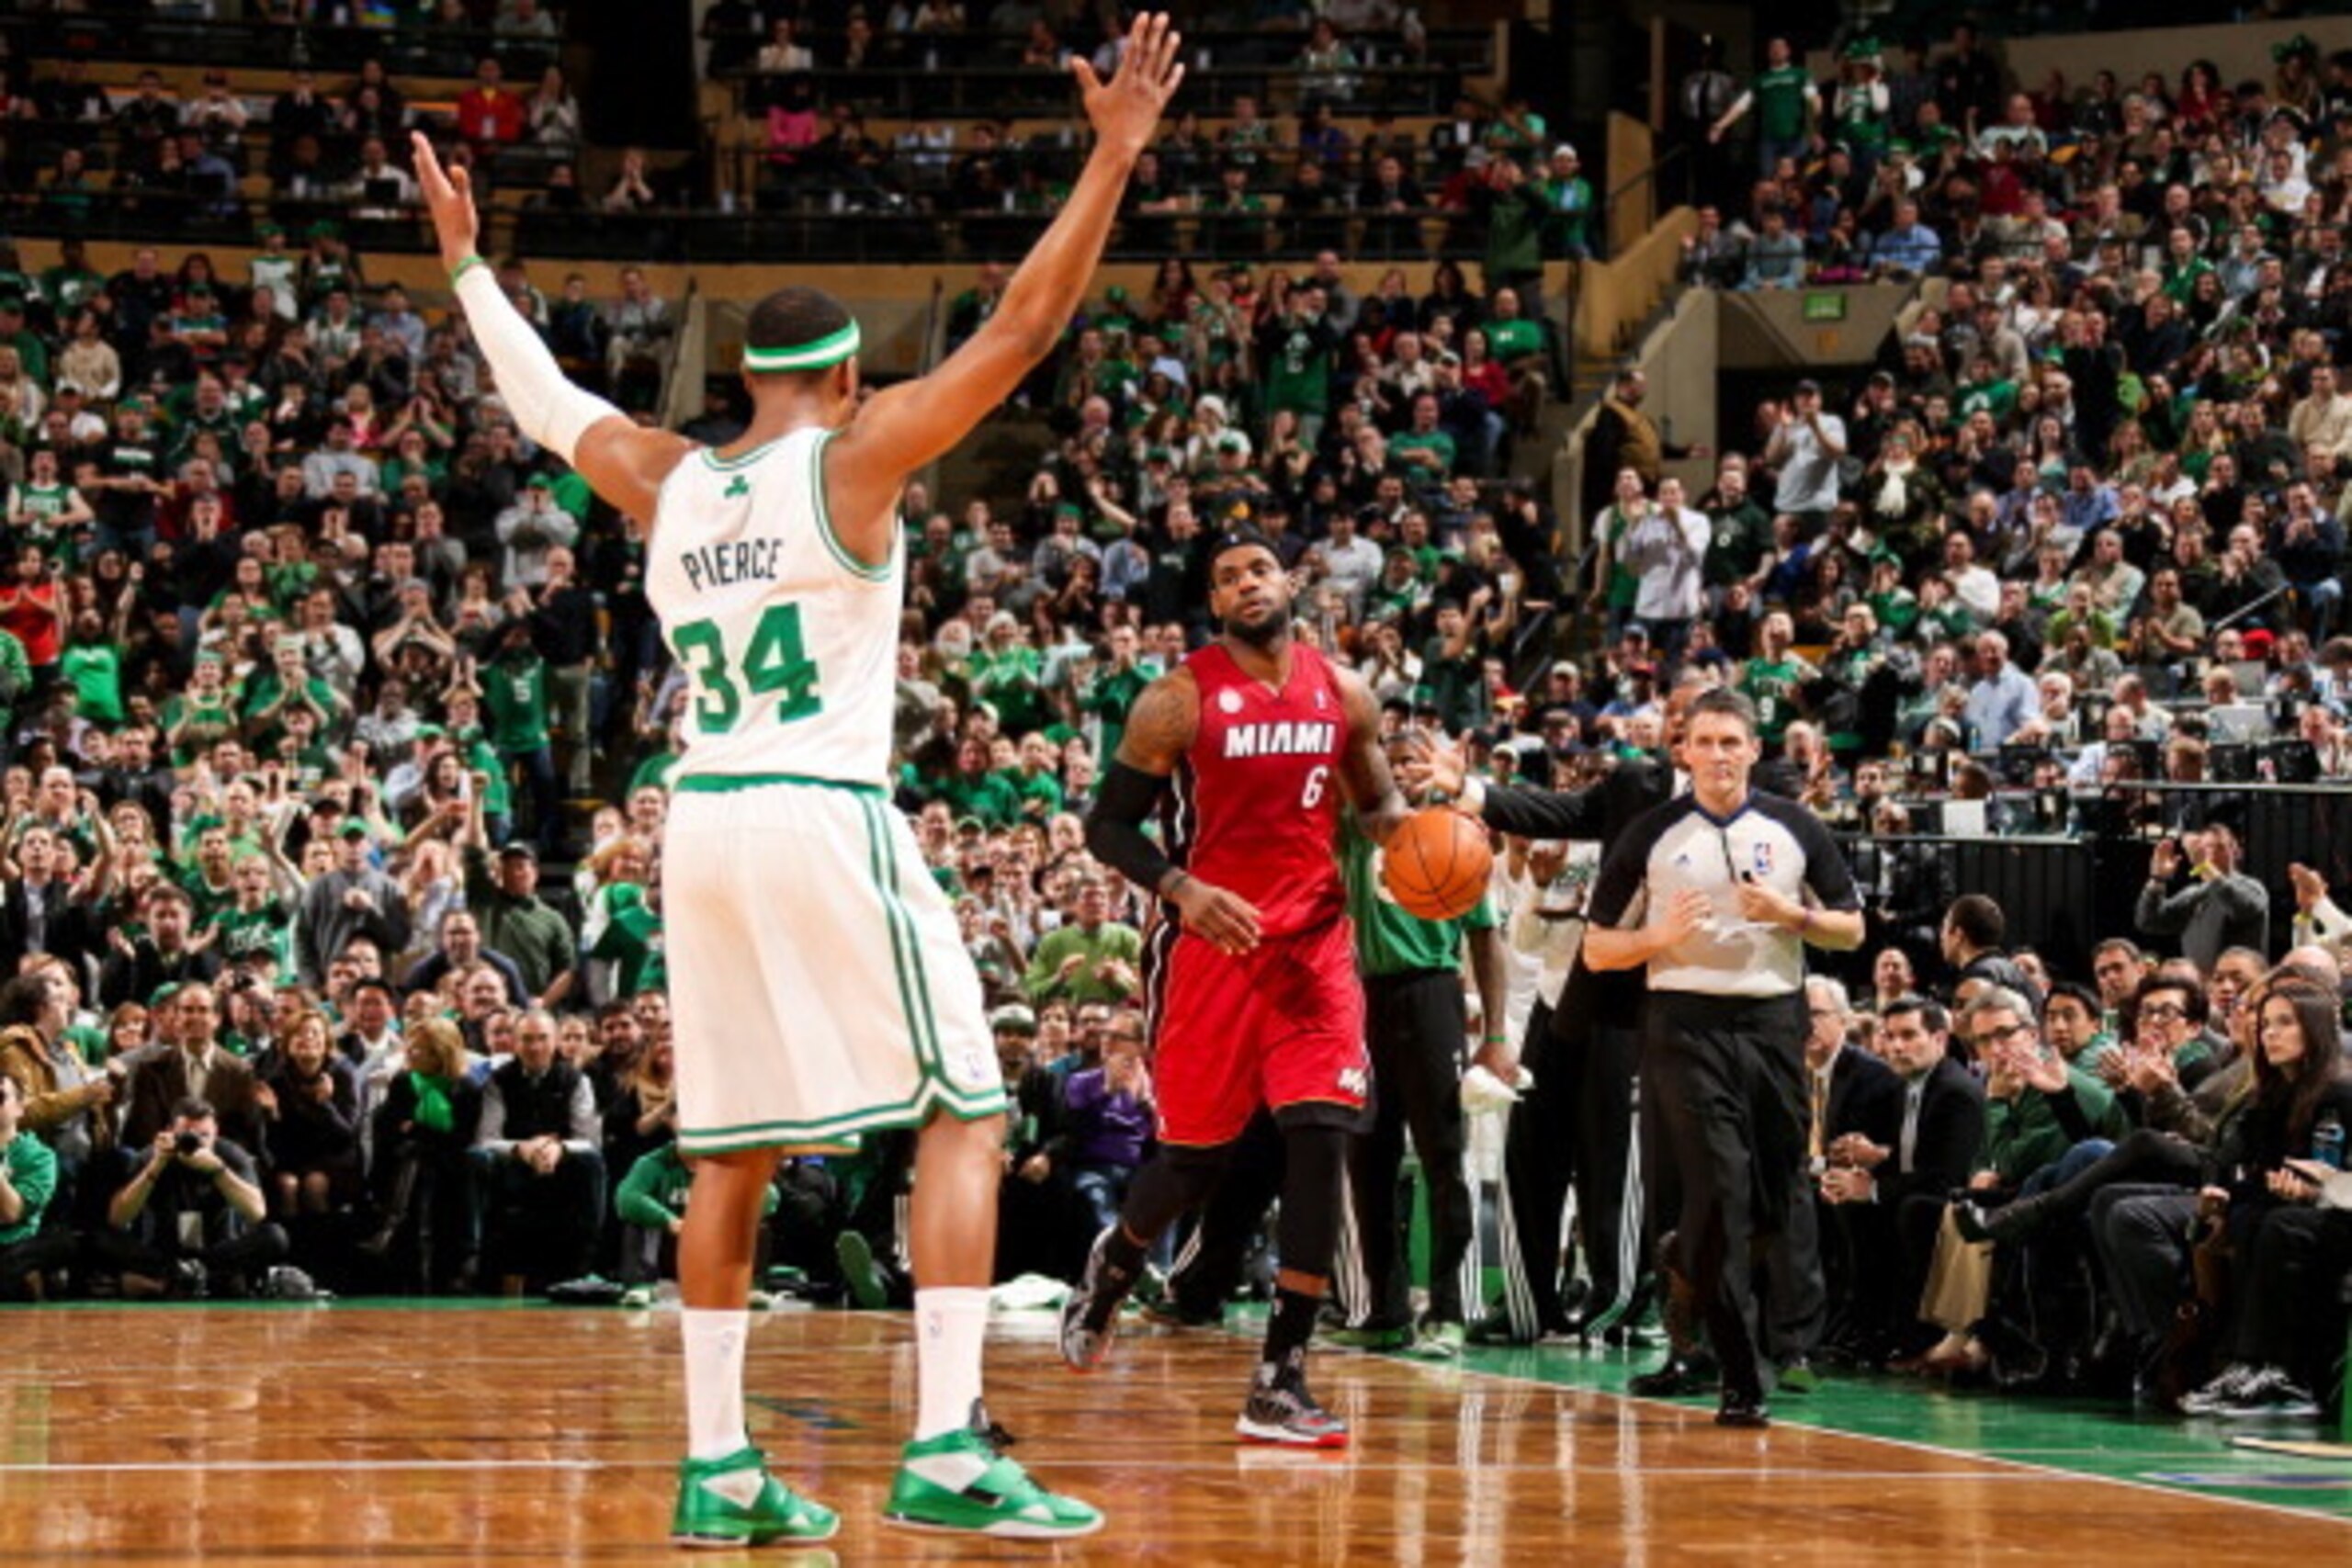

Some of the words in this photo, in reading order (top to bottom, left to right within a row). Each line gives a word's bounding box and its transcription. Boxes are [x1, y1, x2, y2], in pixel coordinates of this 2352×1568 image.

[680, 537, 783, 591] PIERCE
[672, 601, 823, 733] 34
[1224, 721, 1335, 759] MIAMI
[1301, 764, 1329, 808] 6
